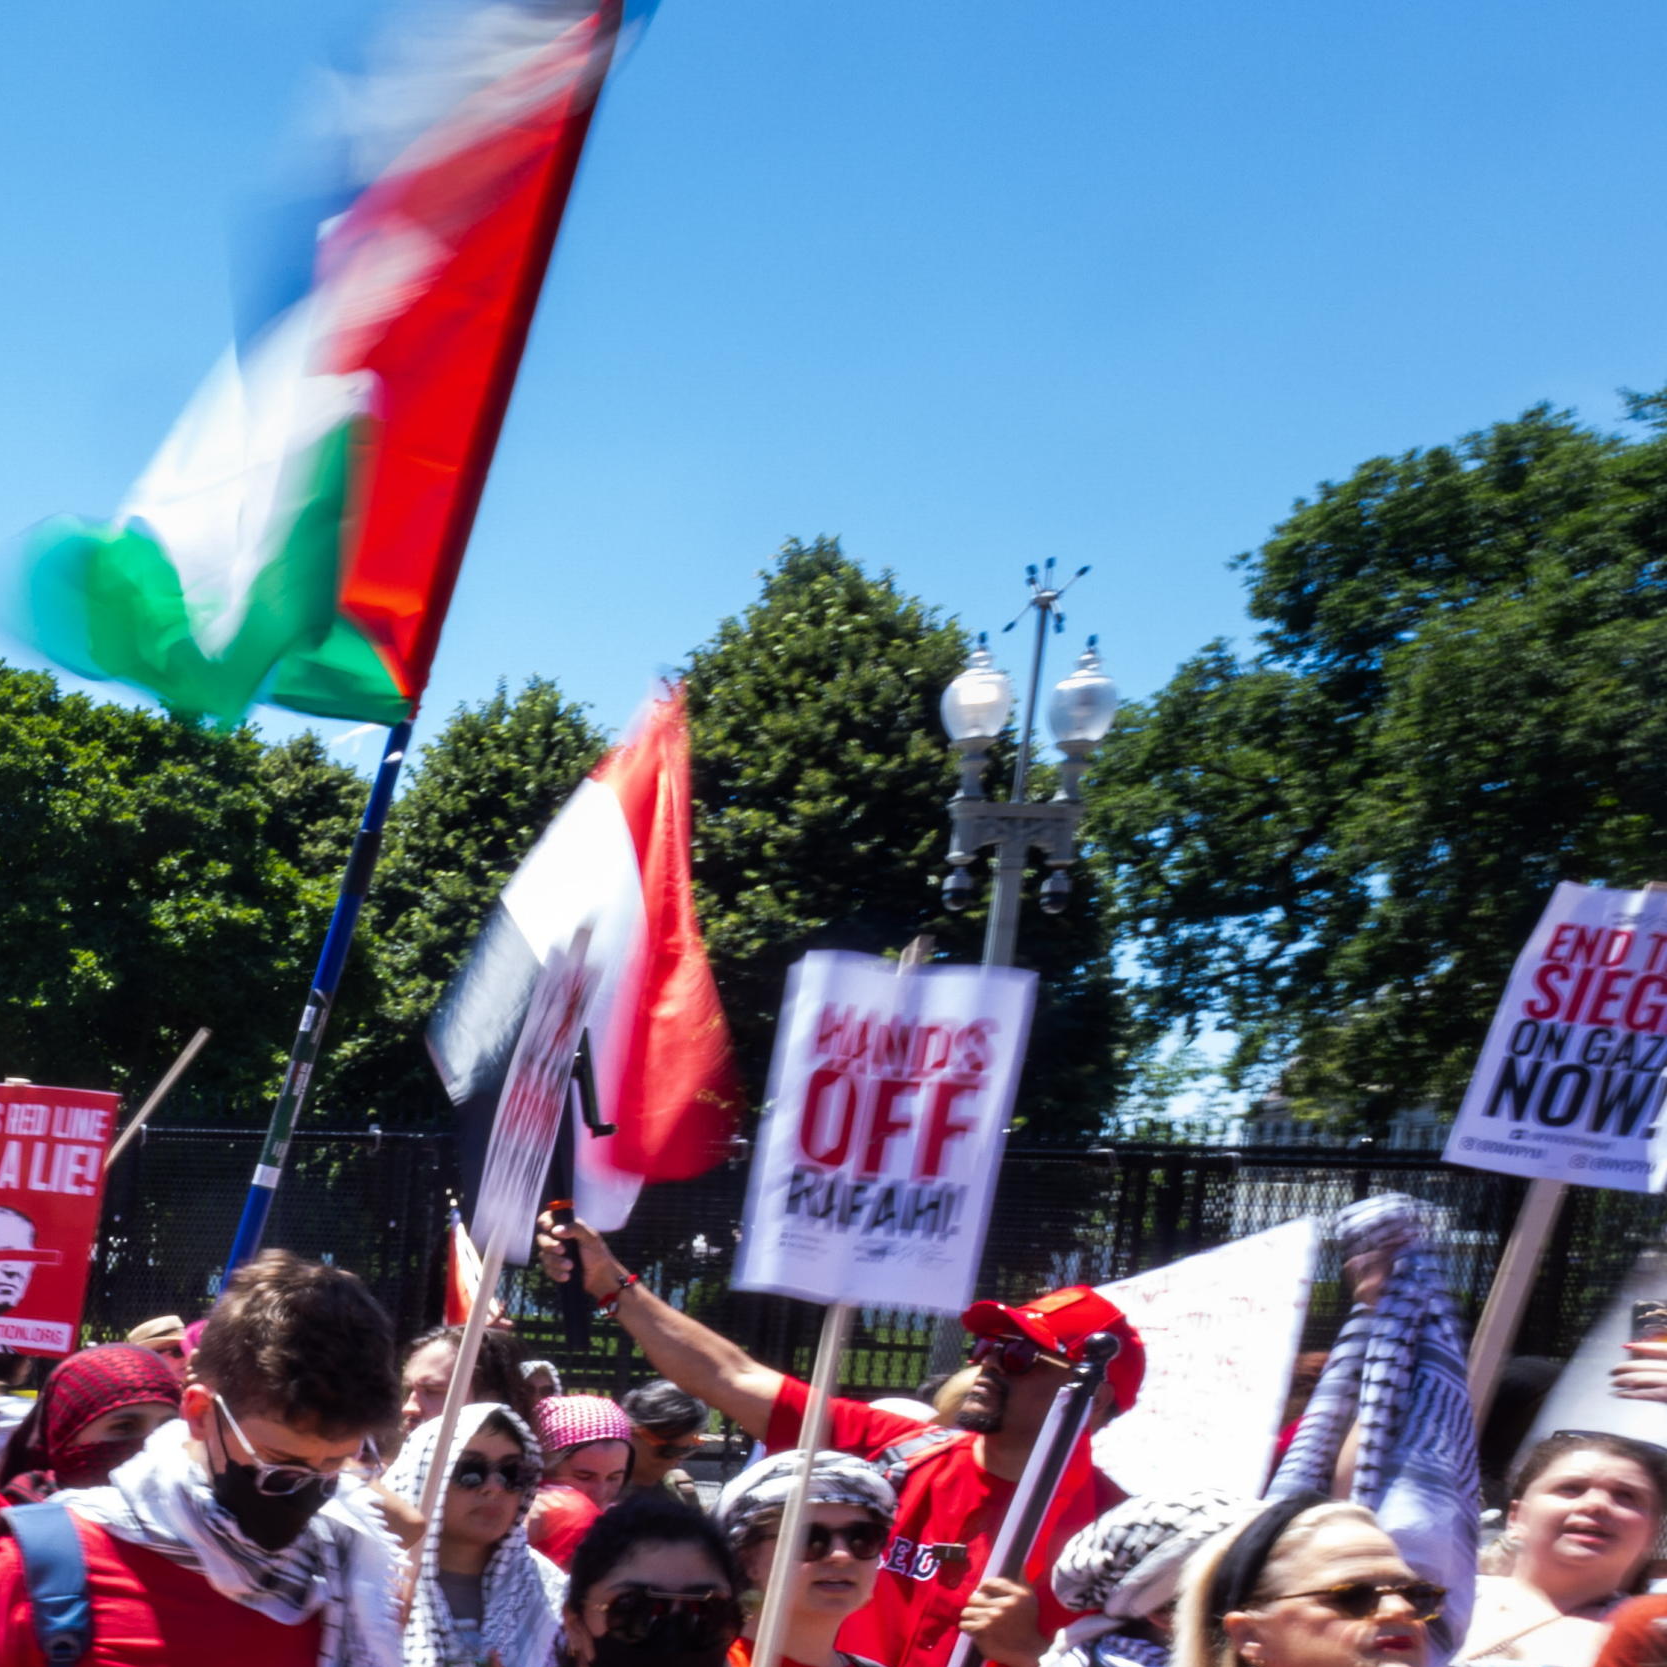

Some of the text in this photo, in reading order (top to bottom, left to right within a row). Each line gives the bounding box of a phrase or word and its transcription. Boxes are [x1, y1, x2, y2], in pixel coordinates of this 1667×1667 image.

[1541, 923, 1636, 970] END
[814, 1002, 999, 1079] HANDS
[1507, 1020, 1573, 1063] ON
[5, 1103, 48, 1136] RED
[52, 1106, 111, 1141] LINE
[800, 1058, 987, 1182] OFF
[28, 1142, 102, 1197] LIE!
